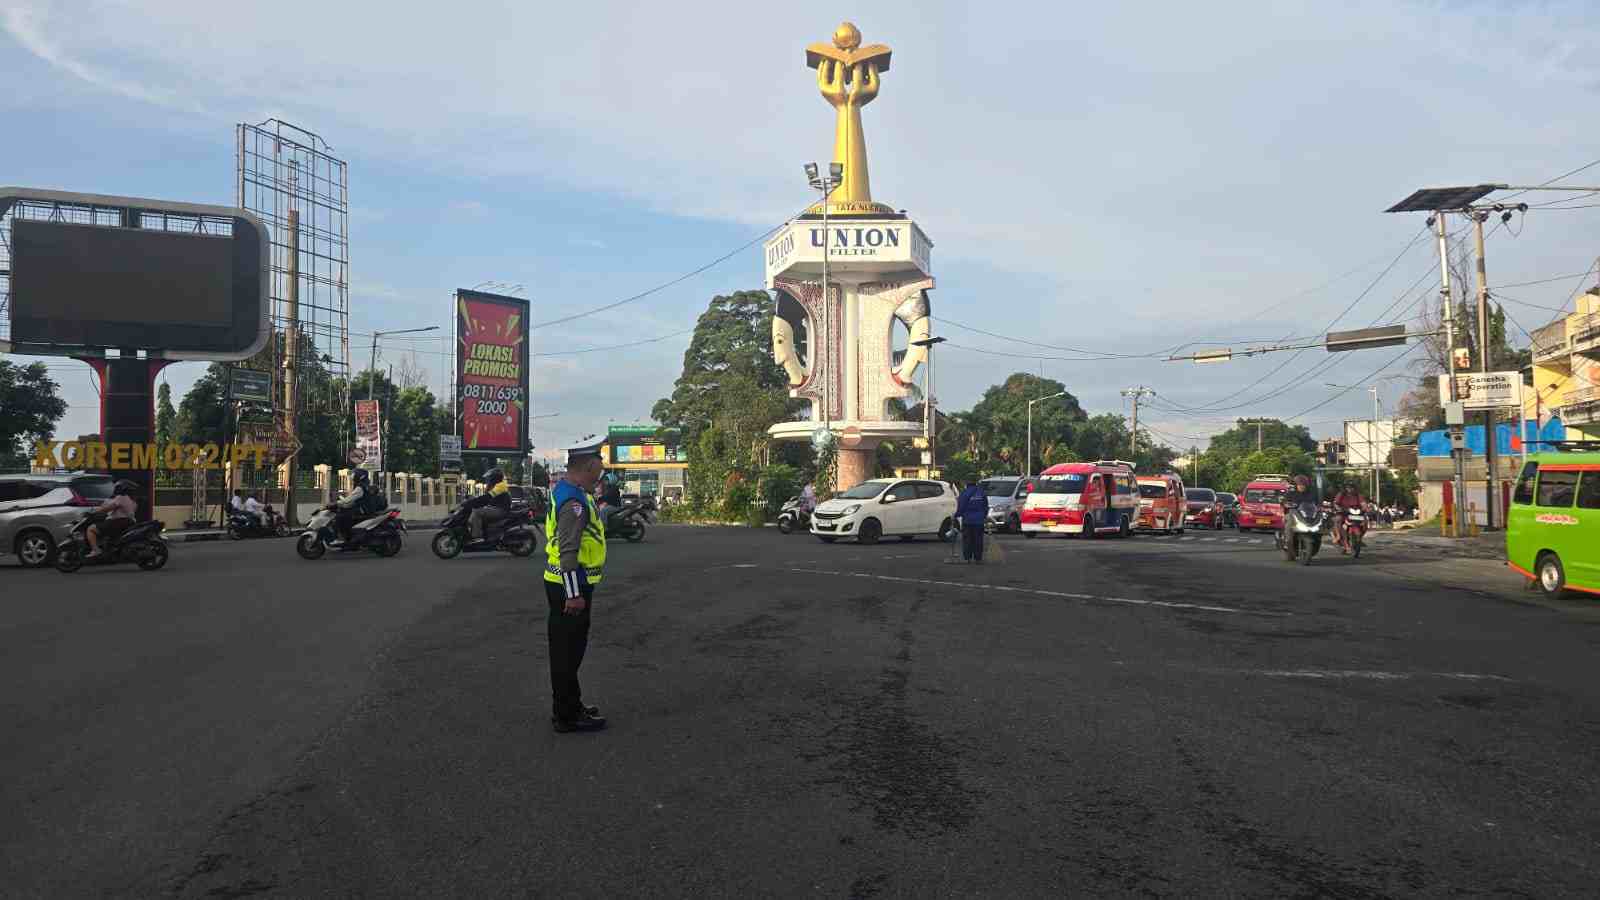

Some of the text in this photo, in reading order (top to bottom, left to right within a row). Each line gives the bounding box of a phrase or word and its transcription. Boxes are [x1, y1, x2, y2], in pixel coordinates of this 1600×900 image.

[810, 228, 901, 247] UNION
[830, 248, 877, 256] FILTER
[470, 343, 513, 362] LOKASI
[464, 359, 520, 379] PROMOSI
[464, 384, 519, 400] 0811 639
[1471, 383, 1512, 391] Operation
[477, 400, 508, 414] 2000
[36, 440, 269, 470] KOREM 022/PT
